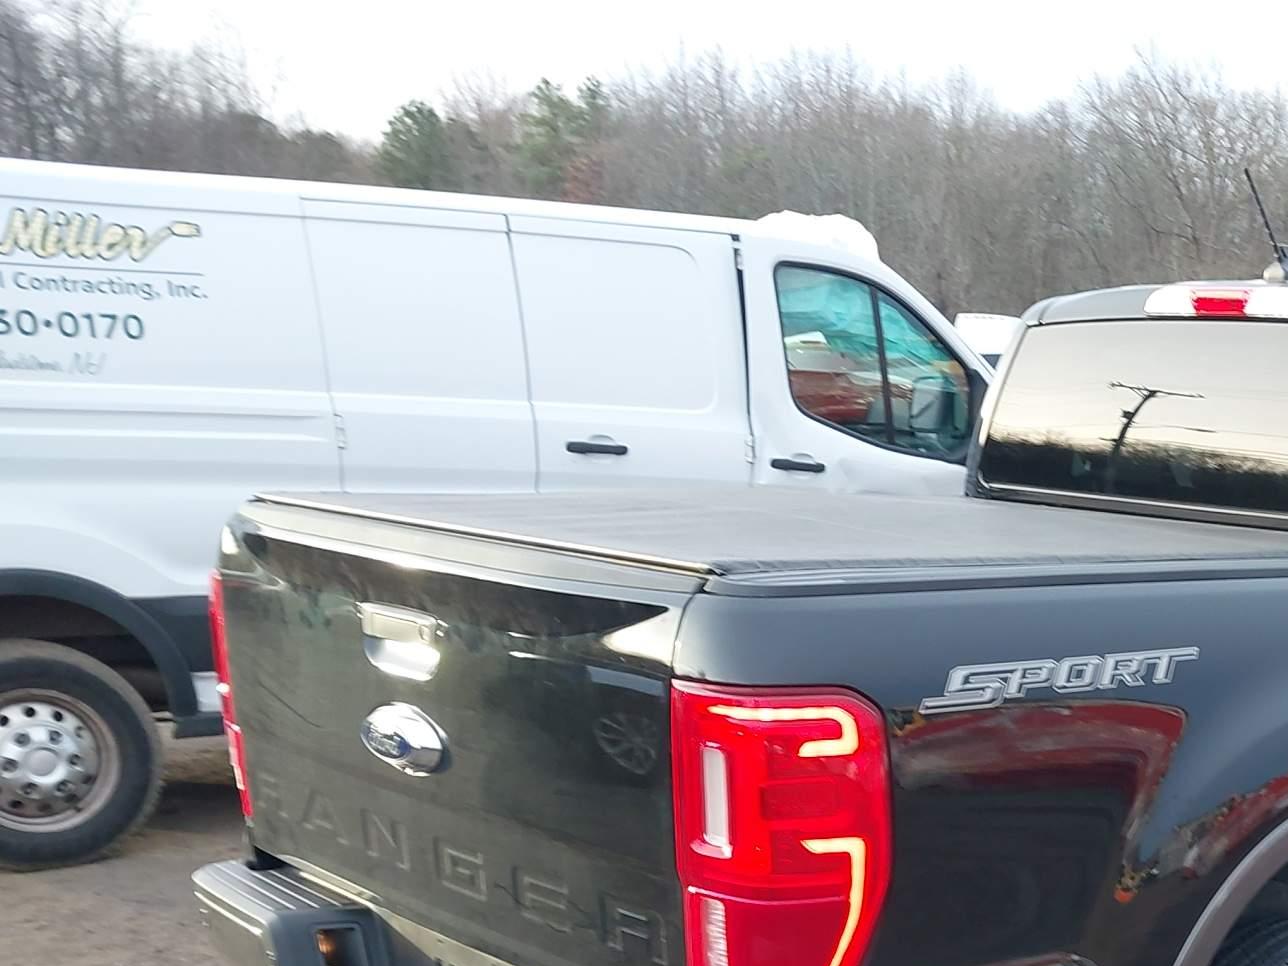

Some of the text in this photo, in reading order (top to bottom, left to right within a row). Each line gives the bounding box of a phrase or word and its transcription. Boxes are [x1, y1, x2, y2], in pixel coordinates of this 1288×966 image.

[0, 207, 170, 262] Miller
[166, 279, 208, 299] Inc.
[918, 646, 1200, 715] SPORT
